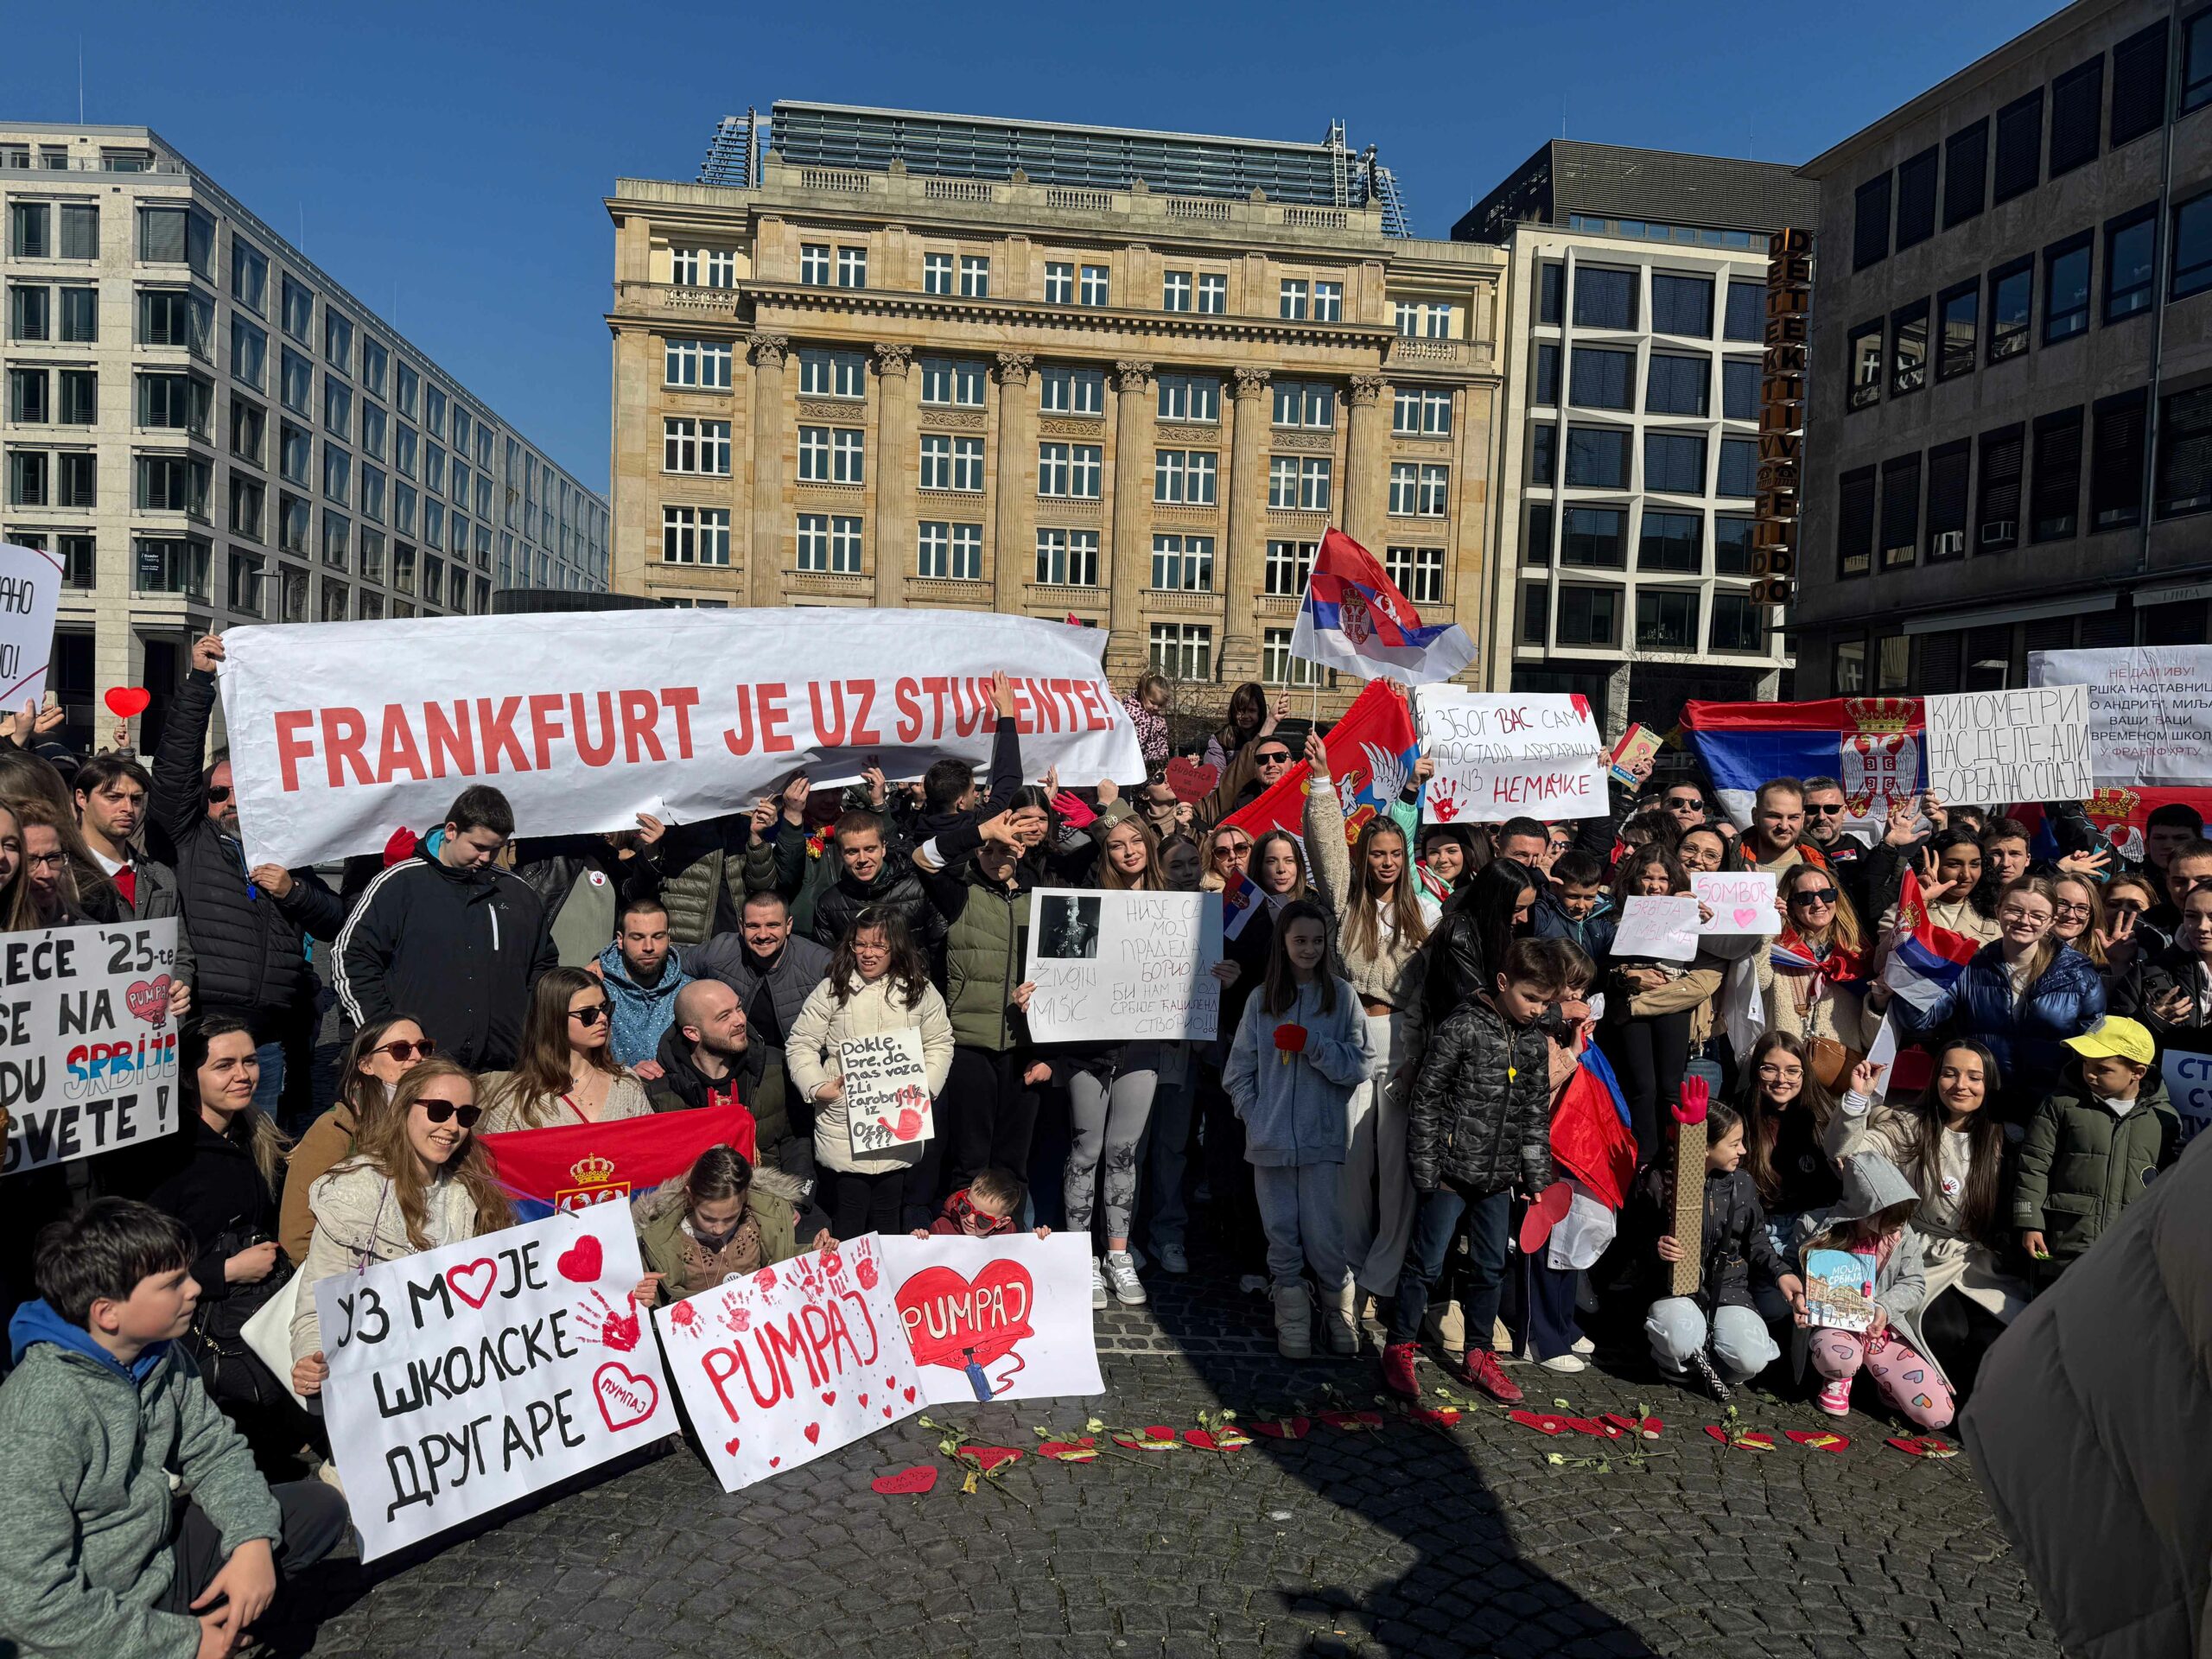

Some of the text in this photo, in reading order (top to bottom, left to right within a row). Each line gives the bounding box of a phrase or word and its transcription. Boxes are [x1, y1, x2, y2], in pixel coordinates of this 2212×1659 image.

[2109, 667, 2195, 678] НЕ ДАМ ИВУ!
[1435, 708, 1489, 741] ЗБОГ
[1494, 707, 1534, 734] ВАС
[1541, 709, 1580, 729] САМ
[1932, 688, 2080, 732] КИЛОМЕТРИ
[2109, 715, 2148, 725] ВАШИ
[274, 687, 699, 791] FRANKFURT
[723, 683, 795, 756] JE
[808, 679, 880, 747] UZ
[1929, 730, 1973, 769] НАС
[2050, 723, 2089, 762] АЛИ
[2101, 747, 2108, 756] У
[1438, 741, 1599, 767] ПОСТАЛА ДРУГАРИЦА
[1460, 768, 1483, 792] ИЗ
[1493, 772, 1591, 804] НЕМАЧКЕ
[1932, 761, 2092, 804] БОРБА НАС СПАЈА
[1697, 877, 1773, 903] SOMBOR
[1127, 899, 1203, 923] НИЈЕ СЕ
[1150, 920, 1188, 938] МОЈ
[0, 931, 76, 988] EĆE
[1122, 938, 1203, 963] ПРАДЕДА
[129, 985, 169, 1009] PUMPA
[1113, 983, 1135, 1001] БИ
[1144, 982, 1169, 999] НАМ
[1198, 983, 1217, 995] ОД
[59, 988, 116, 1036] NA
[1033, 994, 1088, 1028] MIŠIĆ
[846, 1063, 924, 1082] nas voza
[156, 1085, 169, 1133] !
[865, 1105, 880, 1116] iz
[1828, 1274, 1862, 1286] СРБИЈА
[1832, 1262, 1861, 1275] МОЈА
[337, 1287, 391, 1348] УЗ
[900, 1281, 1027, 1344] PUMPAJ
[372, 1308, 579, 1419] ШКОЛСКЕ
[702, 1289, 879, 1424] PUMPAJ
[601, 1378, 647, 1414] ПУМПАЈ
[385, 1389, 586, 1523] ДРУГАРЕ
